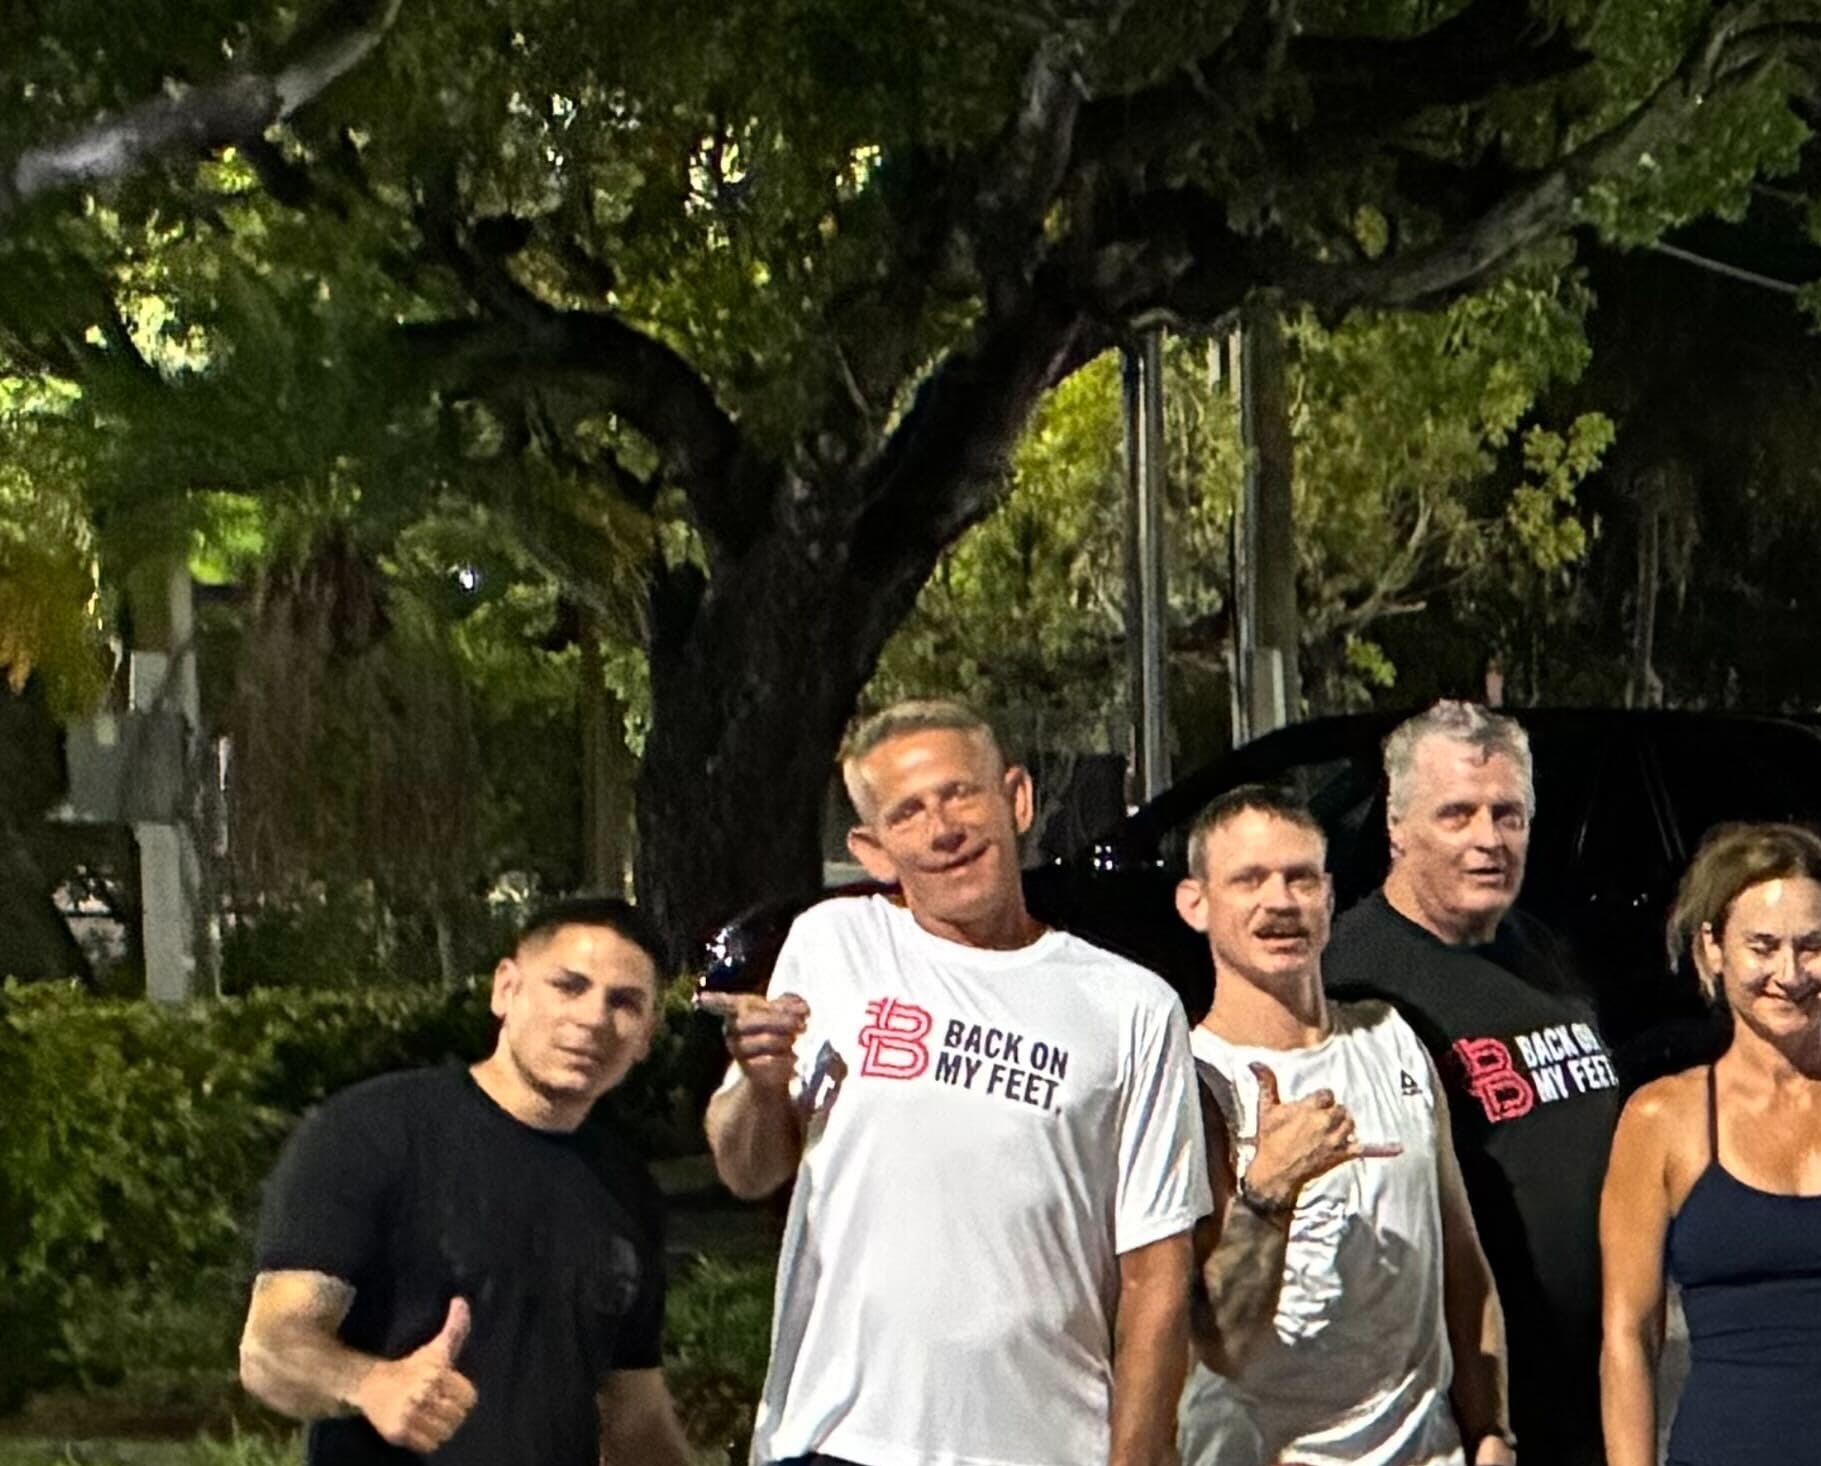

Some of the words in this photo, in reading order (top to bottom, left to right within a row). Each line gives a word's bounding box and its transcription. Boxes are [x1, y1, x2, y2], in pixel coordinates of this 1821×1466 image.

[943, 1018, 1023, 1065] BACK
[1030, 1041, 1069, 1080] ON
[1514, 1023, 1577, 1069] BACK
[935, 1051, 983, 1090] MY
[986, 1063, 1063, 1118] FEET.
[1531, 1065, 1571, 1104] MY
